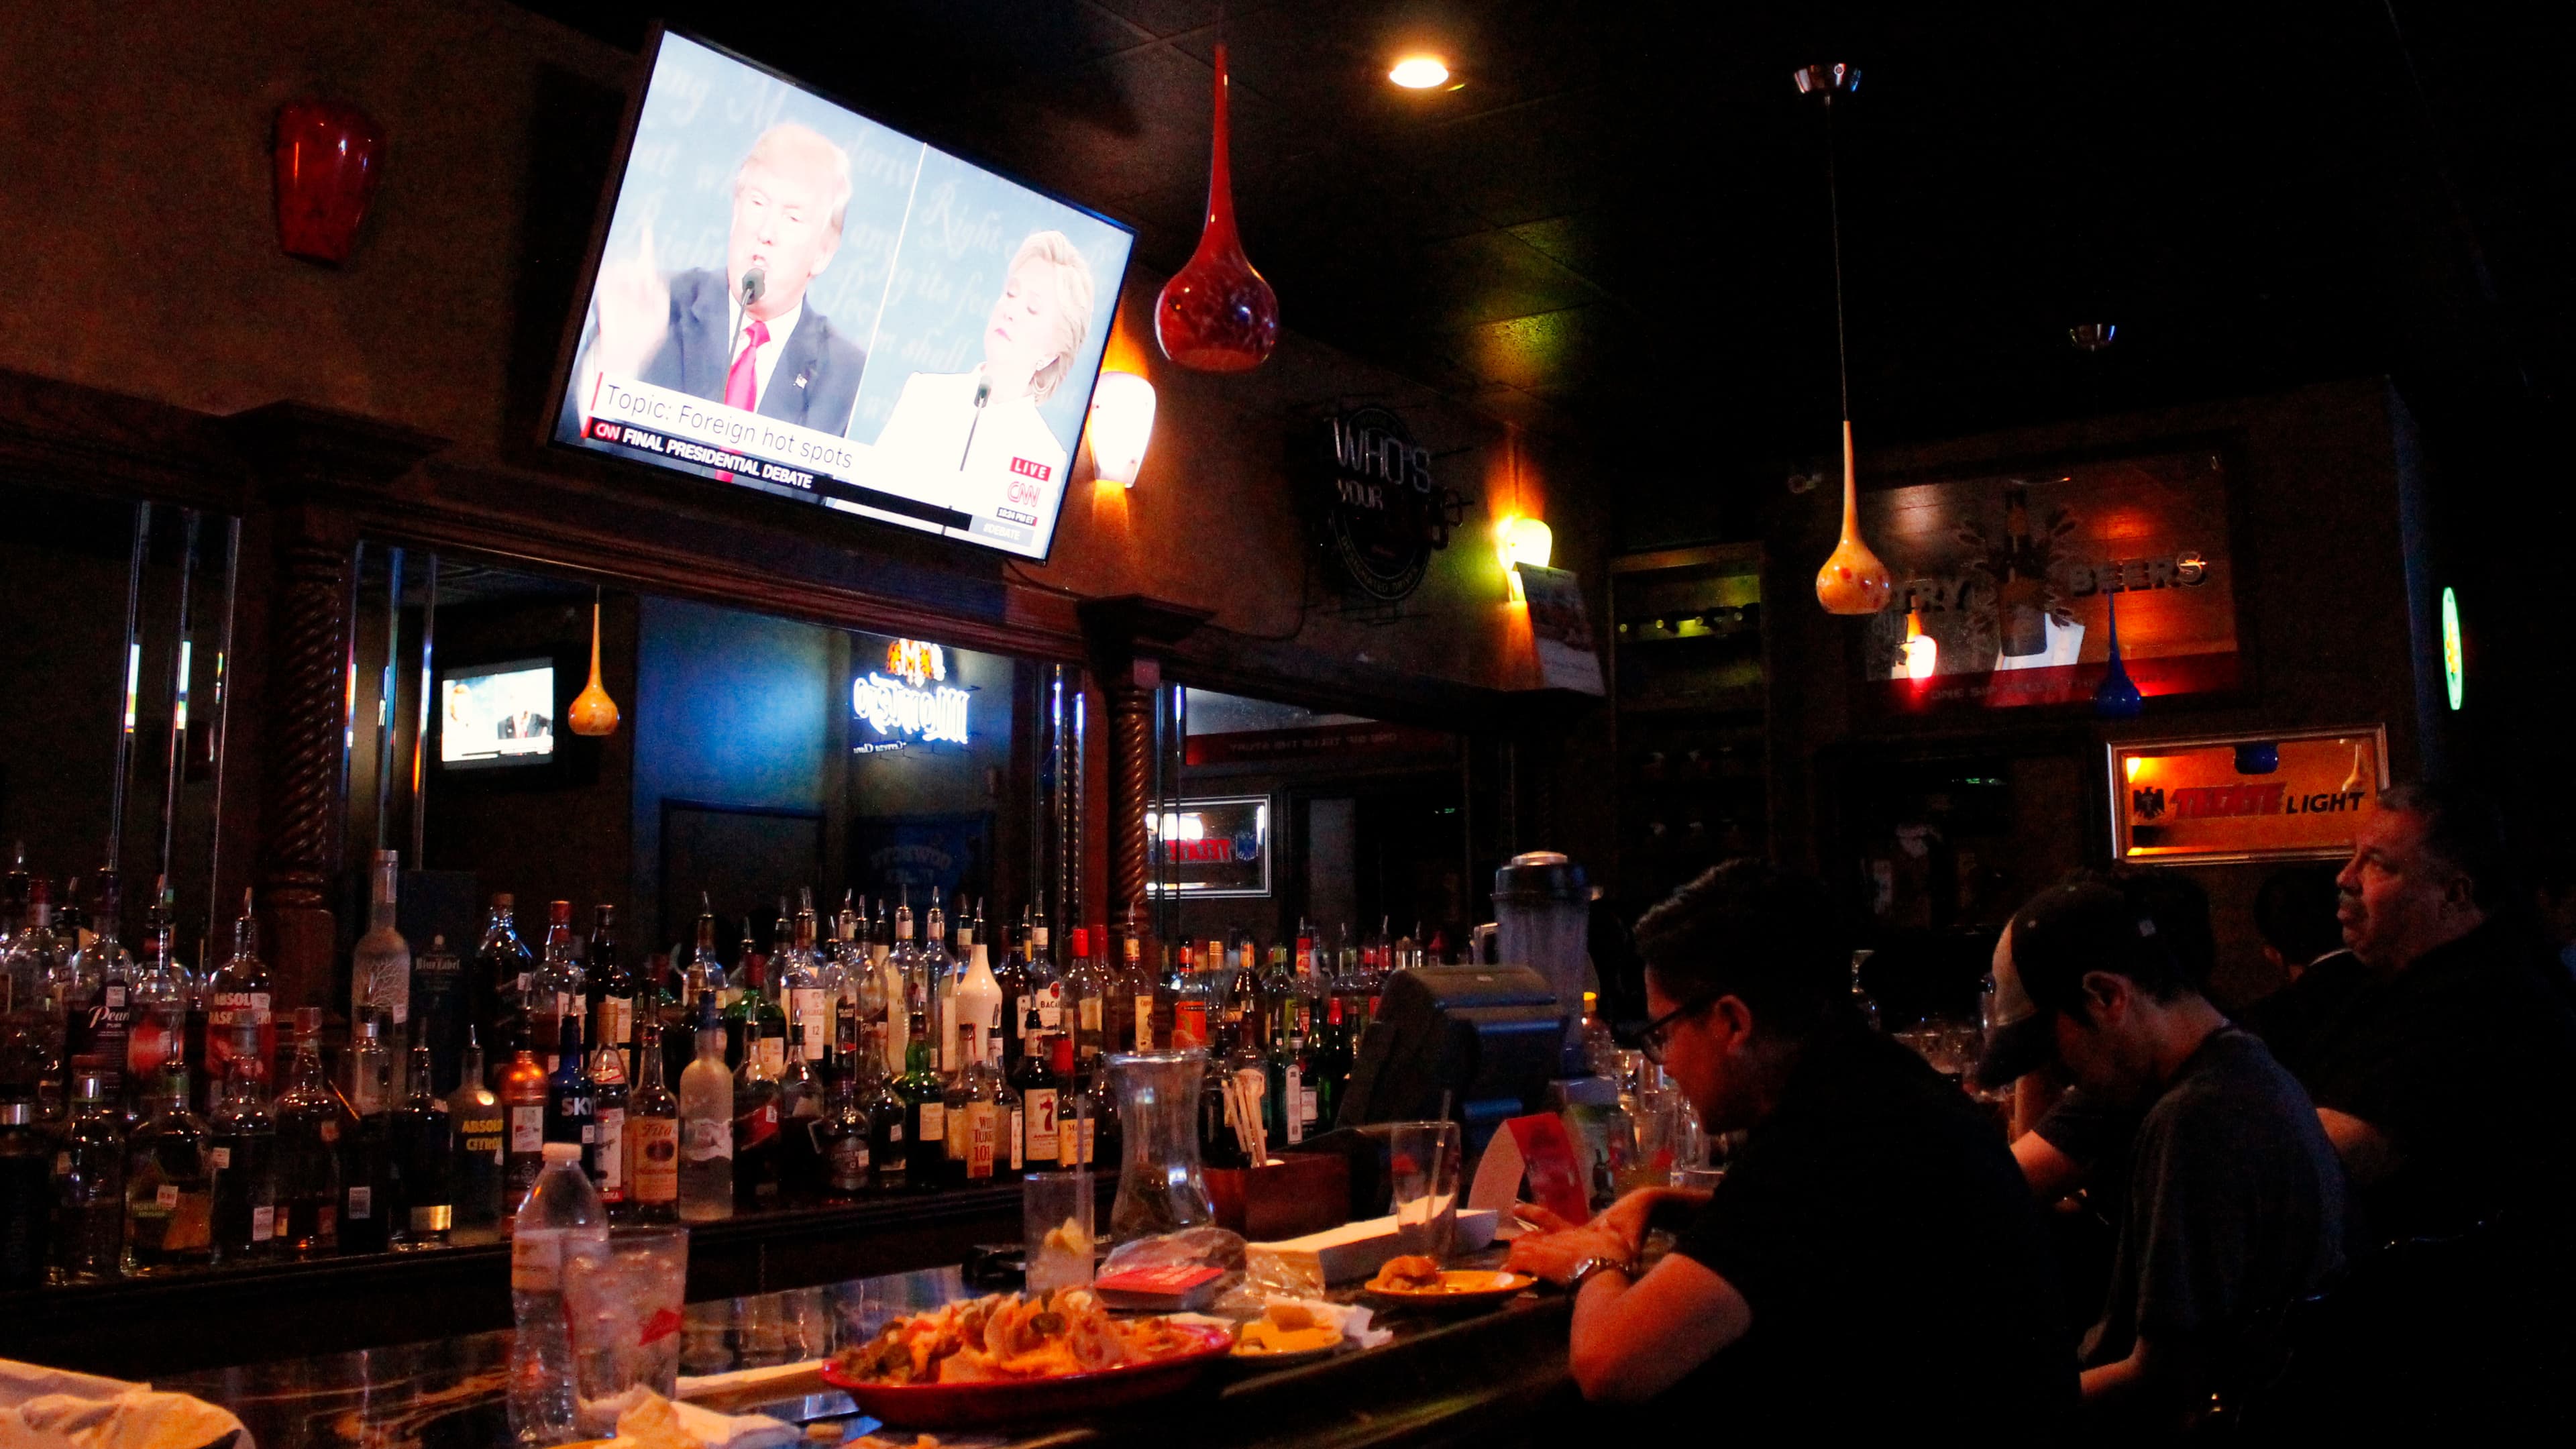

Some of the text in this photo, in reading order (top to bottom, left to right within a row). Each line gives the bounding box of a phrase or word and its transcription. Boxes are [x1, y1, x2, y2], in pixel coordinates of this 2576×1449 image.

[608, 384, 853, 469] Topic: Foreign hot spots
[595, 423, 813, 489] CNN FINAL PRESIDENTIAL DEBATE
[1014, 459, 1046, 478] LIVE
[1008, 481, 1040, 507] CNN
[1336, 478, 1384, 511] YOUR
[2069, 551, 2207, 596] BEERS
[2285, 791, 2366, 814] LIGHT
[1040, 1100, 1054, 1131] 7
[973, 1146, 990, 1161] 101
